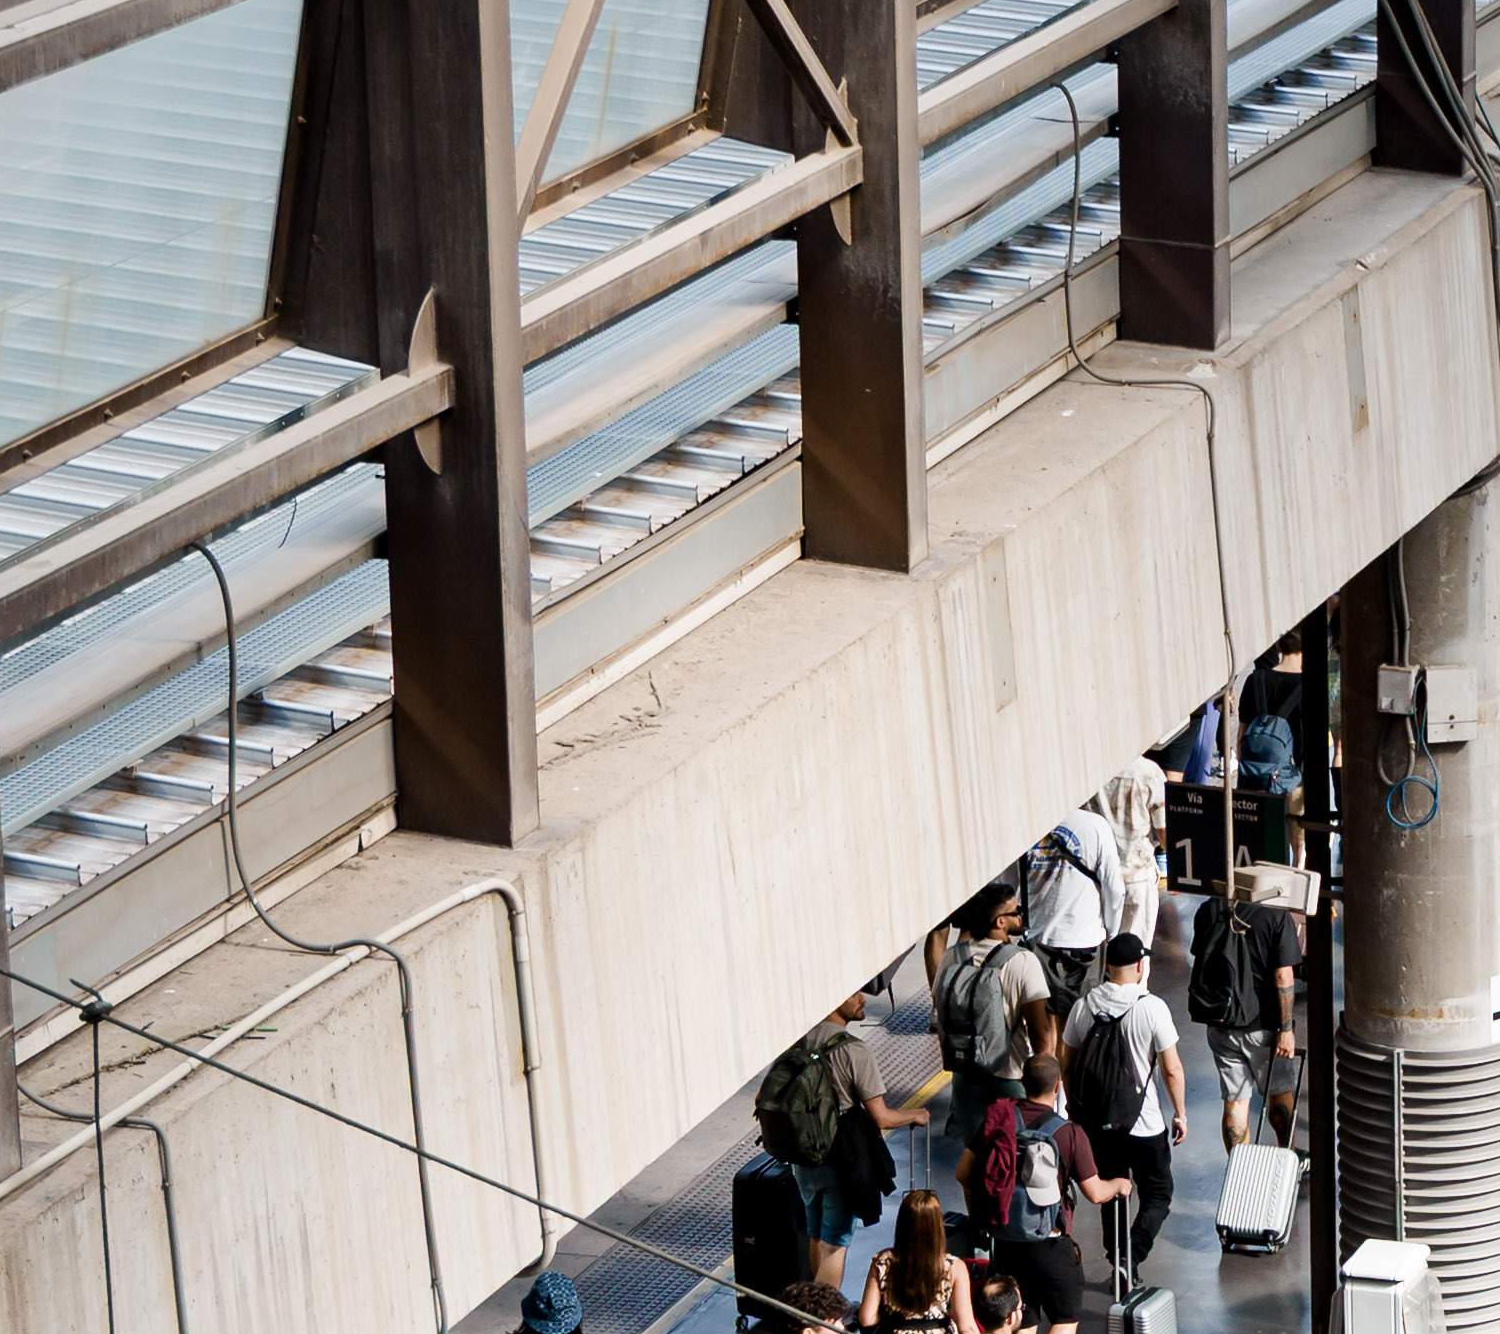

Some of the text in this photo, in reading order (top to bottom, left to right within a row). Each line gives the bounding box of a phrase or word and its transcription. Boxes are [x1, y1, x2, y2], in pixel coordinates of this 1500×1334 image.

[1169, 805, 1203, 815] PLATFORM
[1231, 798, 1258, 811] ector
[1175, 838, 1202, 887] 1
